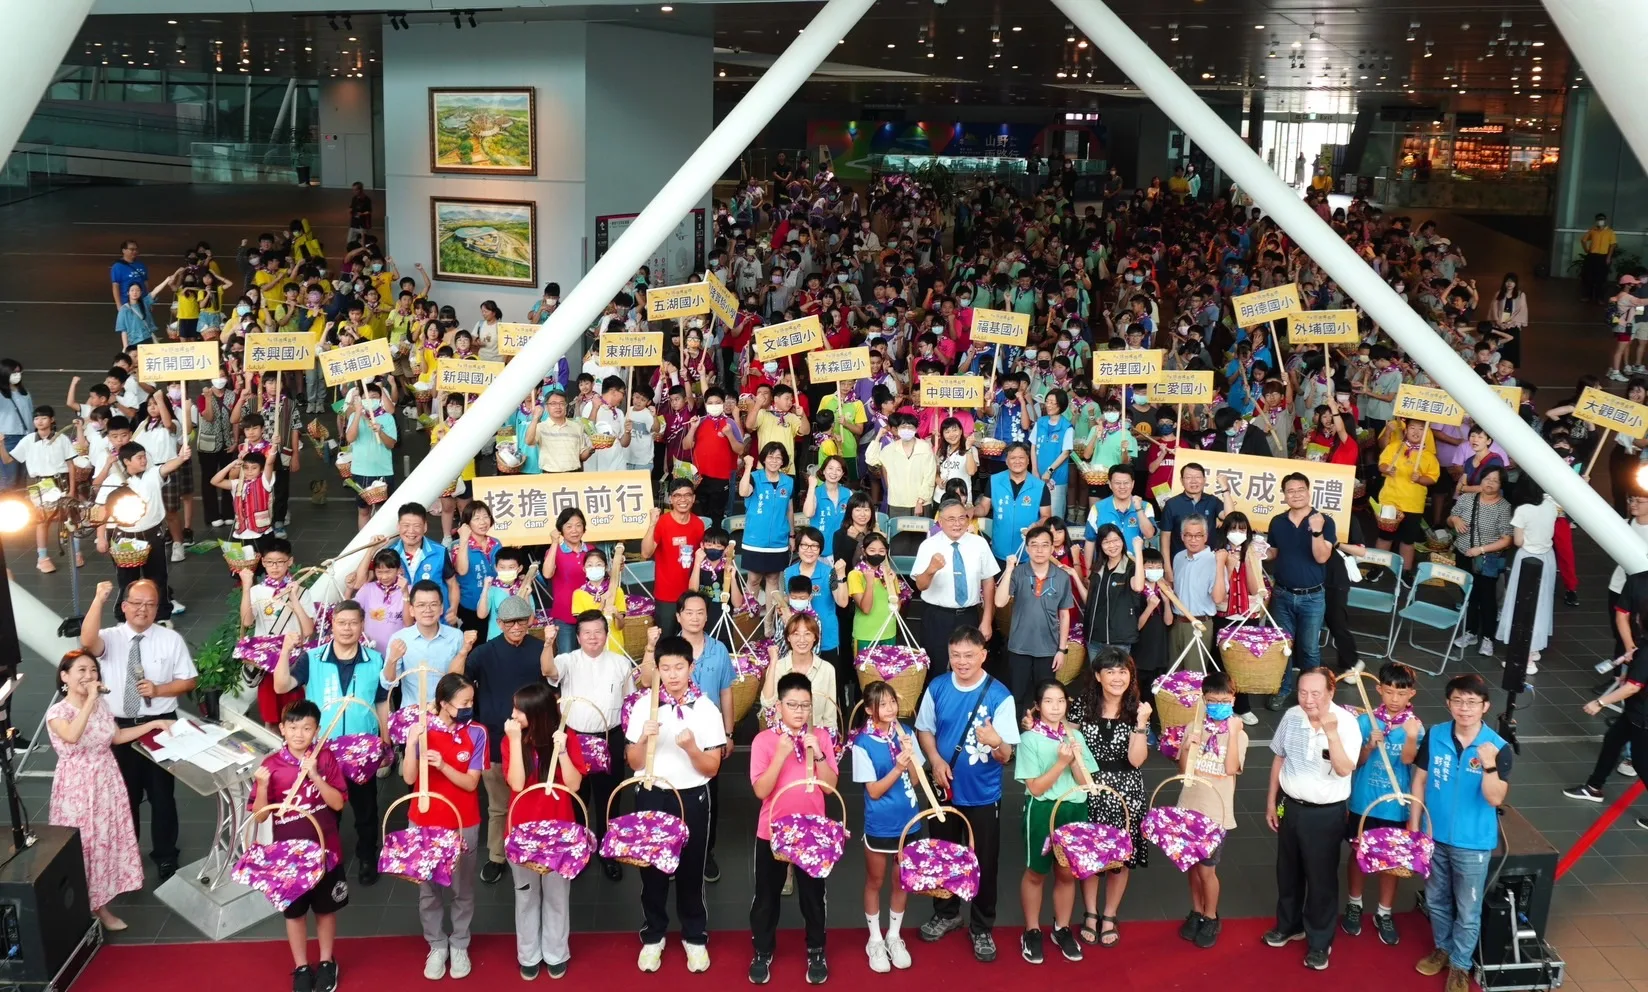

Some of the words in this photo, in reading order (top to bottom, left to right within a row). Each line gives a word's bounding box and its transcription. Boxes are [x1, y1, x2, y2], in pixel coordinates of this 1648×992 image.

[653, 295, 705, 312] 五湖國小
[1240, 296, 1295, 319] 明德國小
[976, 320, 1024, 337] 福基國小
[1294, 321, 1352, 336] 外埔國小
[763, 330, 817, 352] 文峰國小
[251, 344, 310, 362] 泰興國小
[605, 344, 658, 358] 東新國小
[145, 354, 213, 373] 新開國小
[328, 352, 387, 378] 蕉埔國小
[815, 357, 866, 374] 林森國小
[1100, 361, 1157, 376] 苑裡國小
[443, 370, 497, 386] 新興國小
[926, 385, 979, 400] 中興國小
[1153, 381, 1208, 396] 仁愛國小
[1401, 396, 1459, 418] 新隆國小
[1582, 399, 1643, 428] 大觀國小
